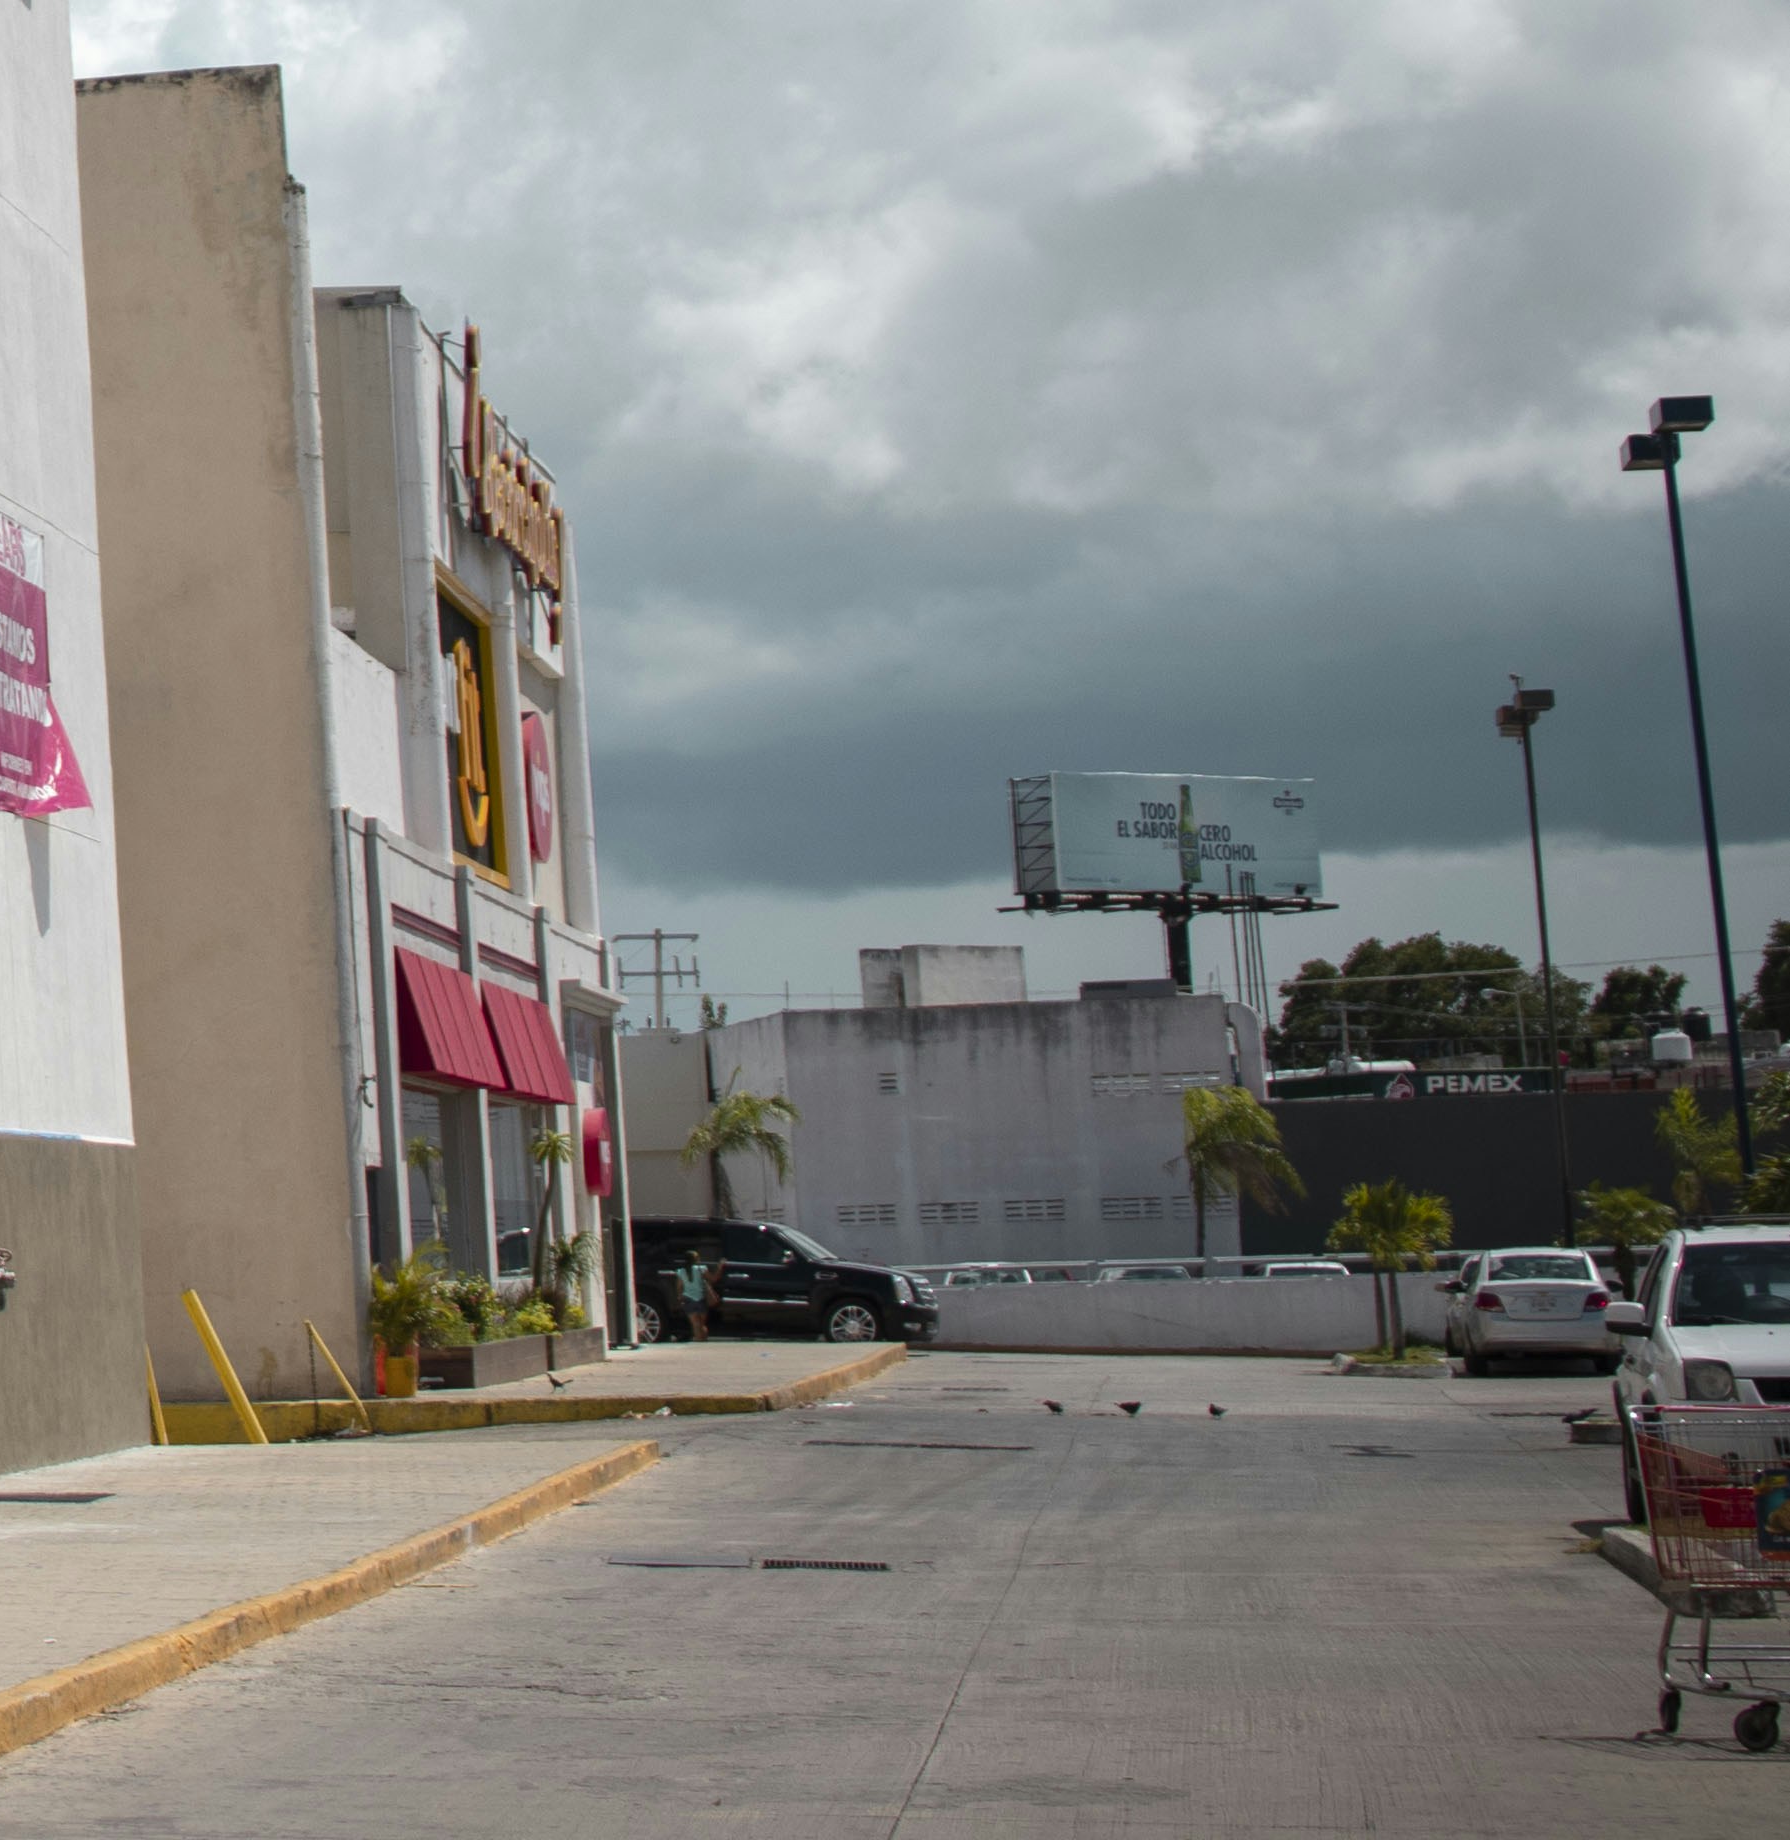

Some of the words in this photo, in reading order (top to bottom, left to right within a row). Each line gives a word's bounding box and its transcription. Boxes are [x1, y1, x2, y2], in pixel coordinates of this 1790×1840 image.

[1140, 802, 1177, 821] TODO
[1117, 820, 1130, 838] EL
[1134, 821, 1178, 840] SABOR
[1199, 824, 1231, 843] CERO
[1200, 843, 1258, 862] ALCOHOL
[1425, 1073, 1524, 1094] PEMEX
